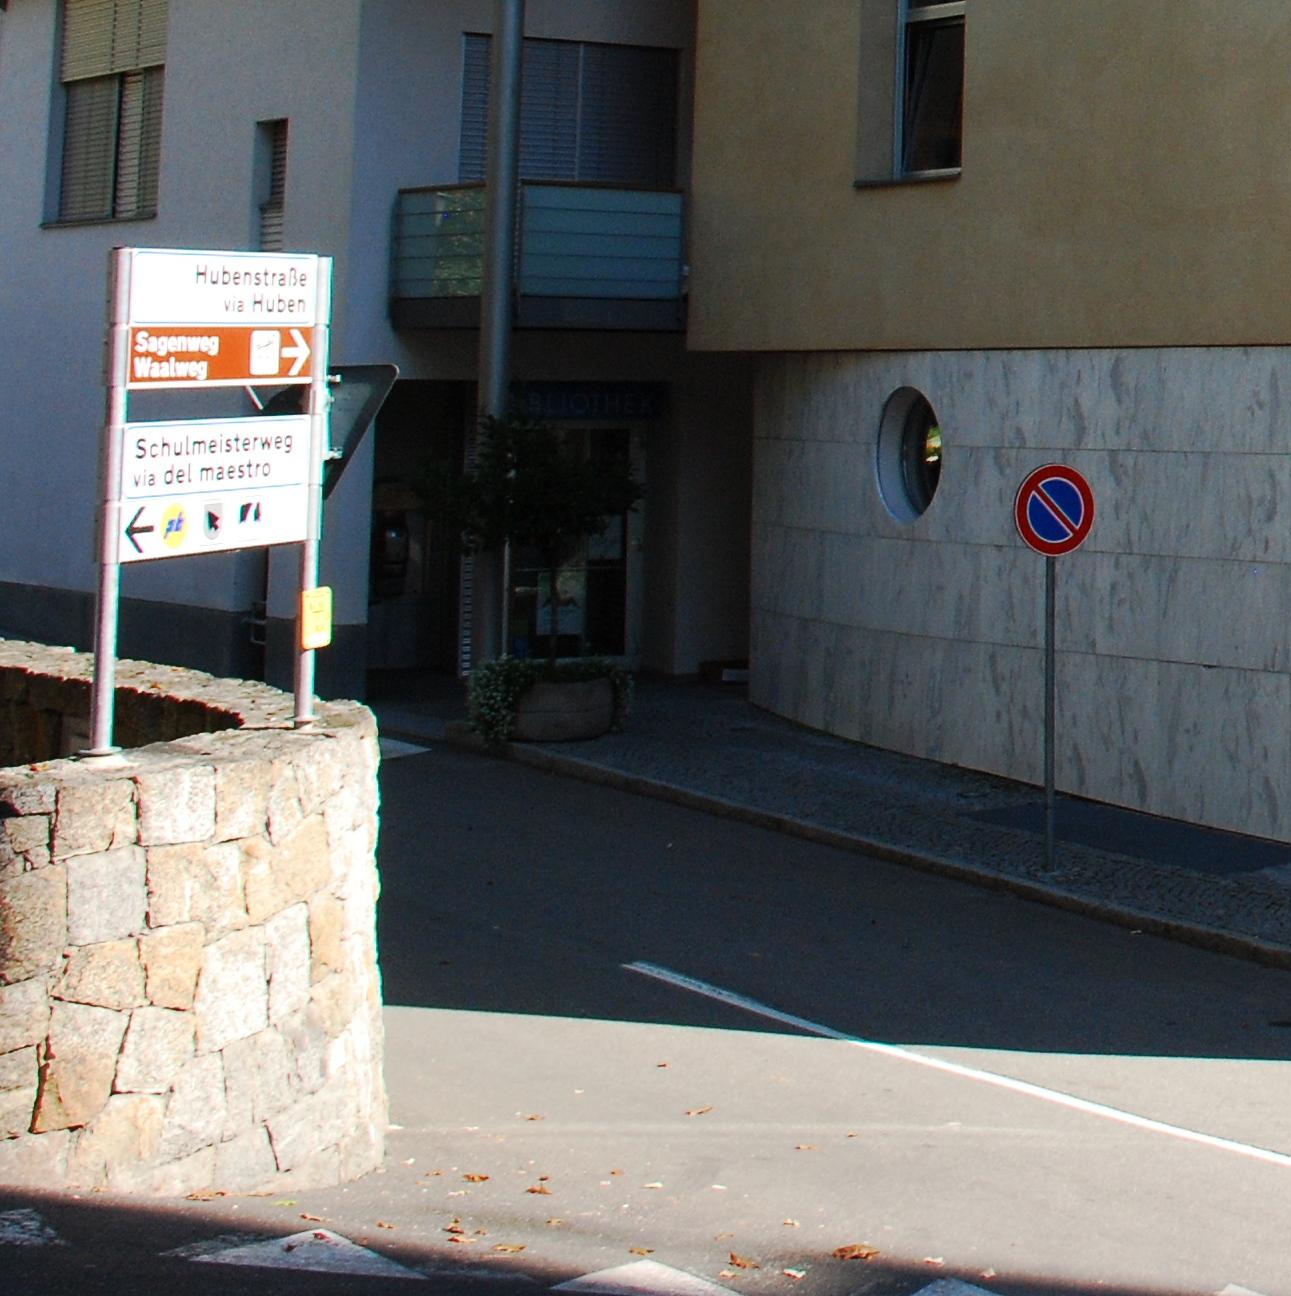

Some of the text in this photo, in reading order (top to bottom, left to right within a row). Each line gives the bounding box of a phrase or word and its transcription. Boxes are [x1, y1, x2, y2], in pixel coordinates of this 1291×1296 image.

[195, 265, 308, 287] Hubenstraße
[223, 294, 306, 313] via Huben
[134, 330, 220, 355] Sagenweg
[134, 357, 208, 380] Waalweg
[135, 433, 293, 459] Schulmeisterweg
[133, 462, 271, 487] via del maestro
